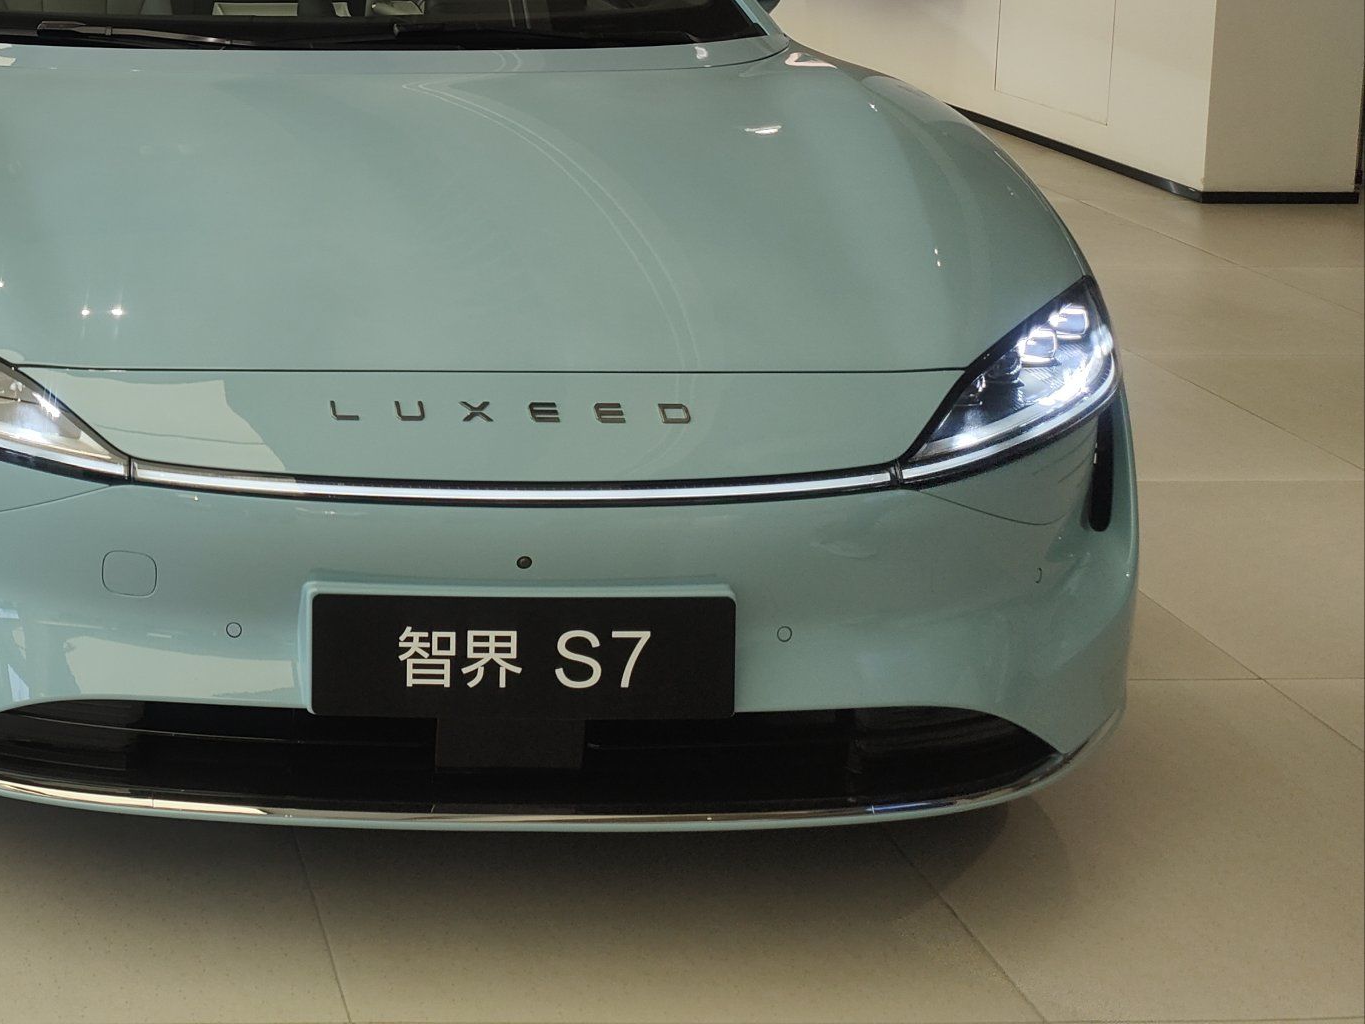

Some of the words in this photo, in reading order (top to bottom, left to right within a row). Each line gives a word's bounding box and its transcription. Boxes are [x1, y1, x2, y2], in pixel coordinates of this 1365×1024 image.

[328, 399, 692, 425] LUXEED
[397, 626, 523, 690] 智界
[554, 629, 652, 690] S7
